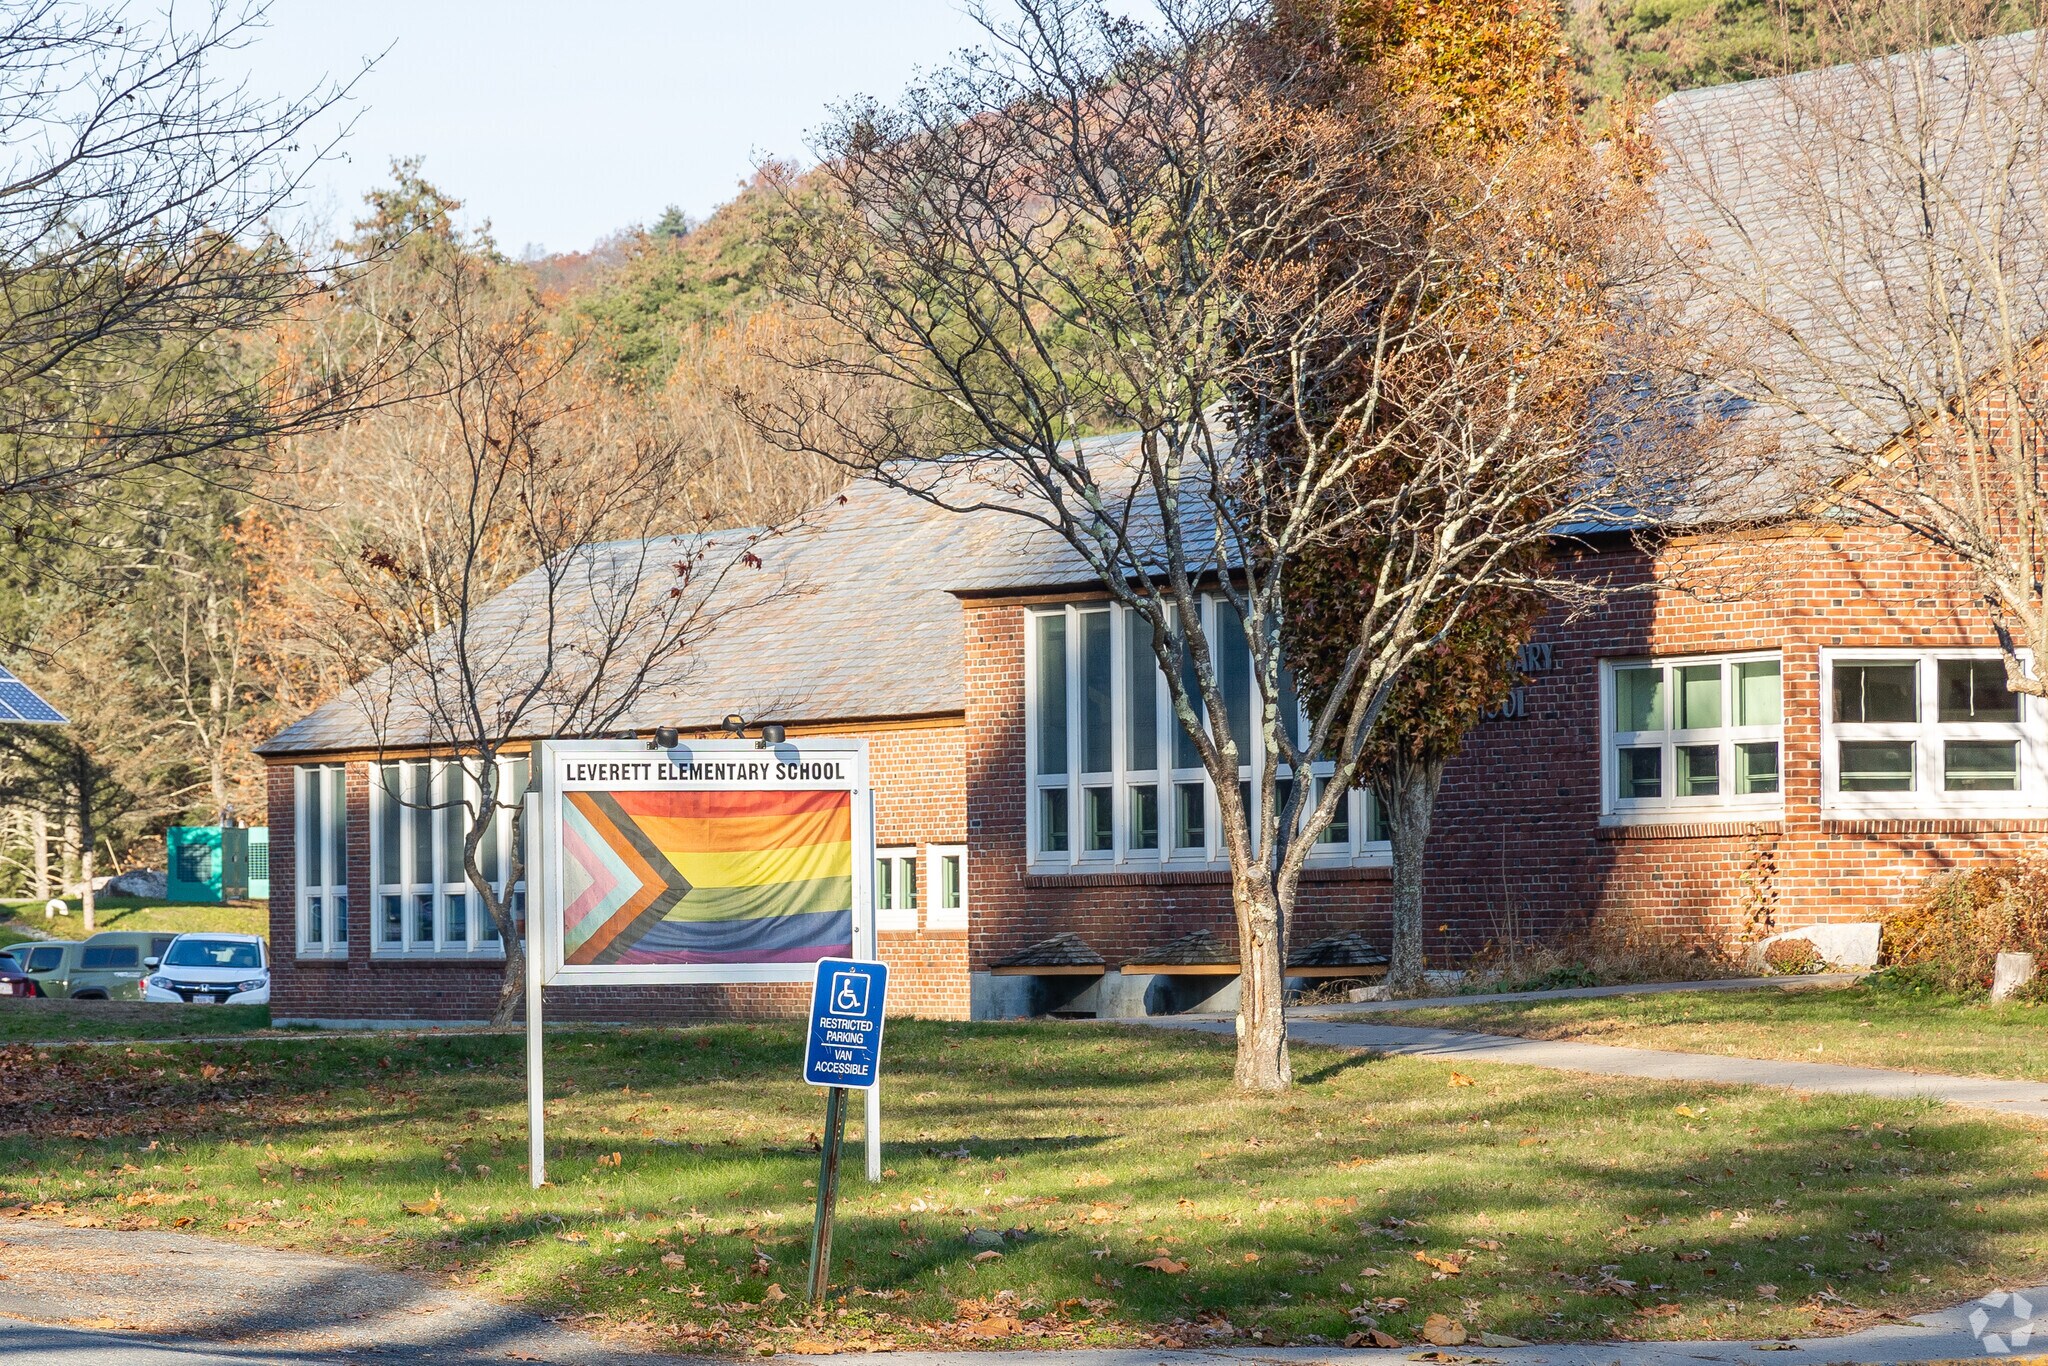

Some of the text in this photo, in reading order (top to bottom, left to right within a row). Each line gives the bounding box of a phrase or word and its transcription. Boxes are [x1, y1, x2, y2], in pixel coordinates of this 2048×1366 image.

[566, 762, 845, 781] LEVERETT ELEMENTARY SCHOOL
[820, 1017, 873, 1032] RESTRICTED
[826, 1031, 864, 1044] PARKING
[834, 1049, 853, 1061] VAN
[814, 1061, 869, 1076] ACCESSIBLE
